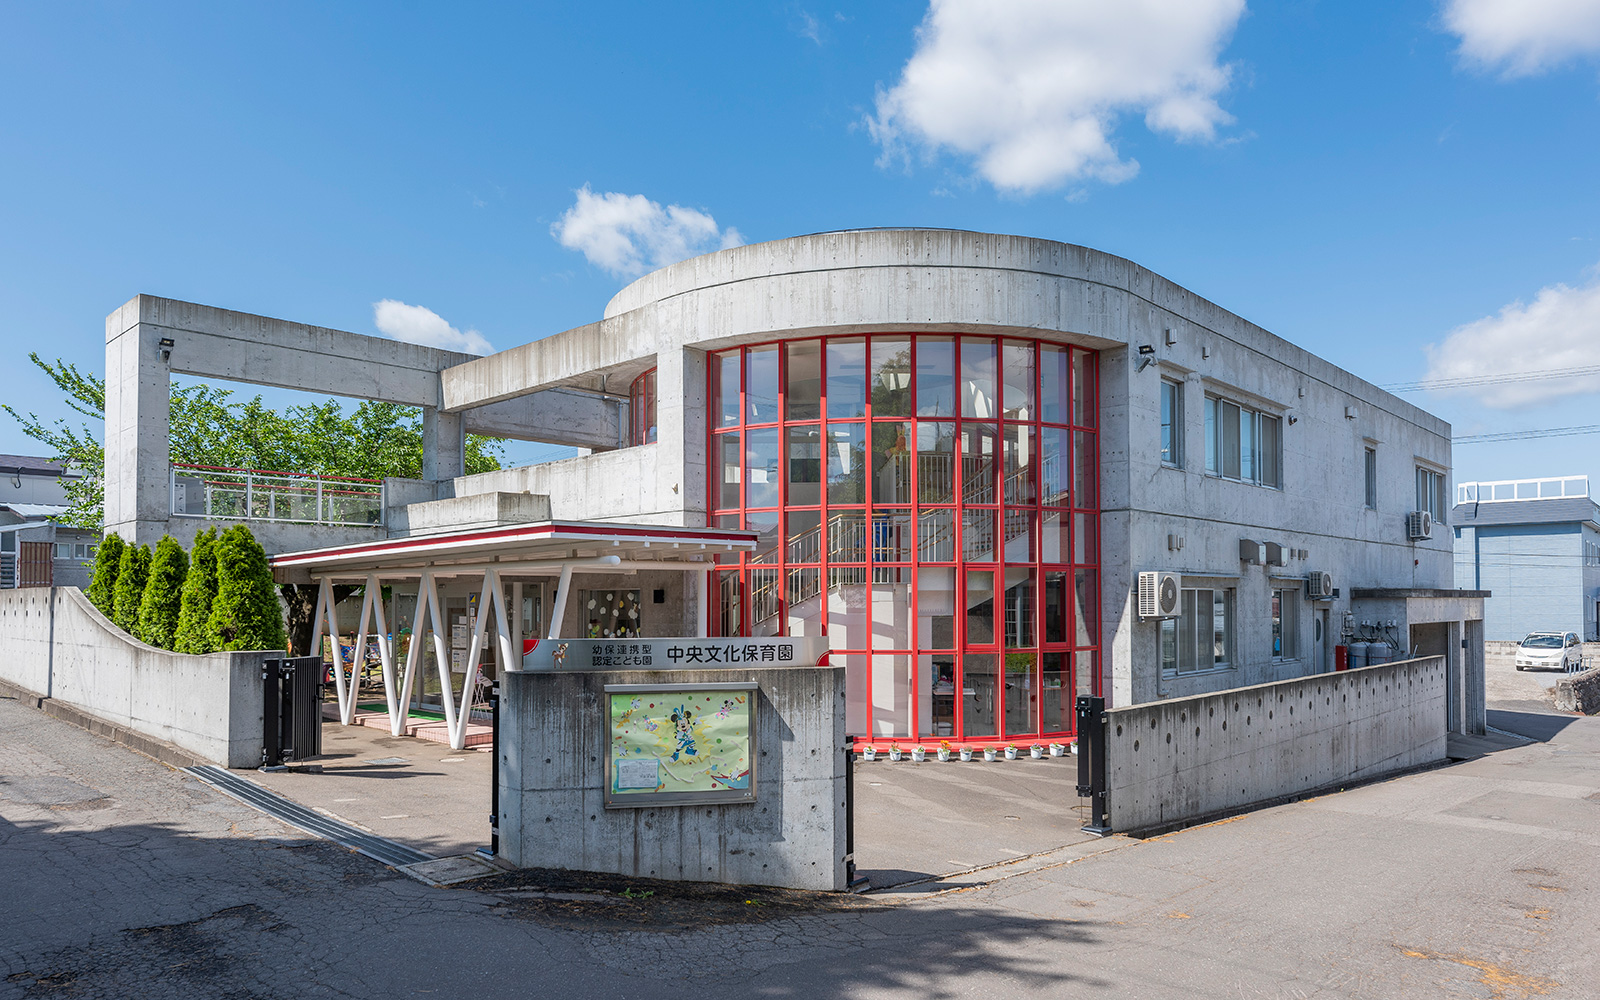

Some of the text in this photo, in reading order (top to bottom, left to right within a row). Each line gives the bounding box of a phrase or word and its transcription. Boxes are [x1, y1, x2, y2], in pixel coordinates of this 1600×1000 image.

[592, 644, 652, 655] 幼保連携型
[667, 644, 793, 663] 中央文化保育園
[592, 656, 652, 666] 認定こども園
